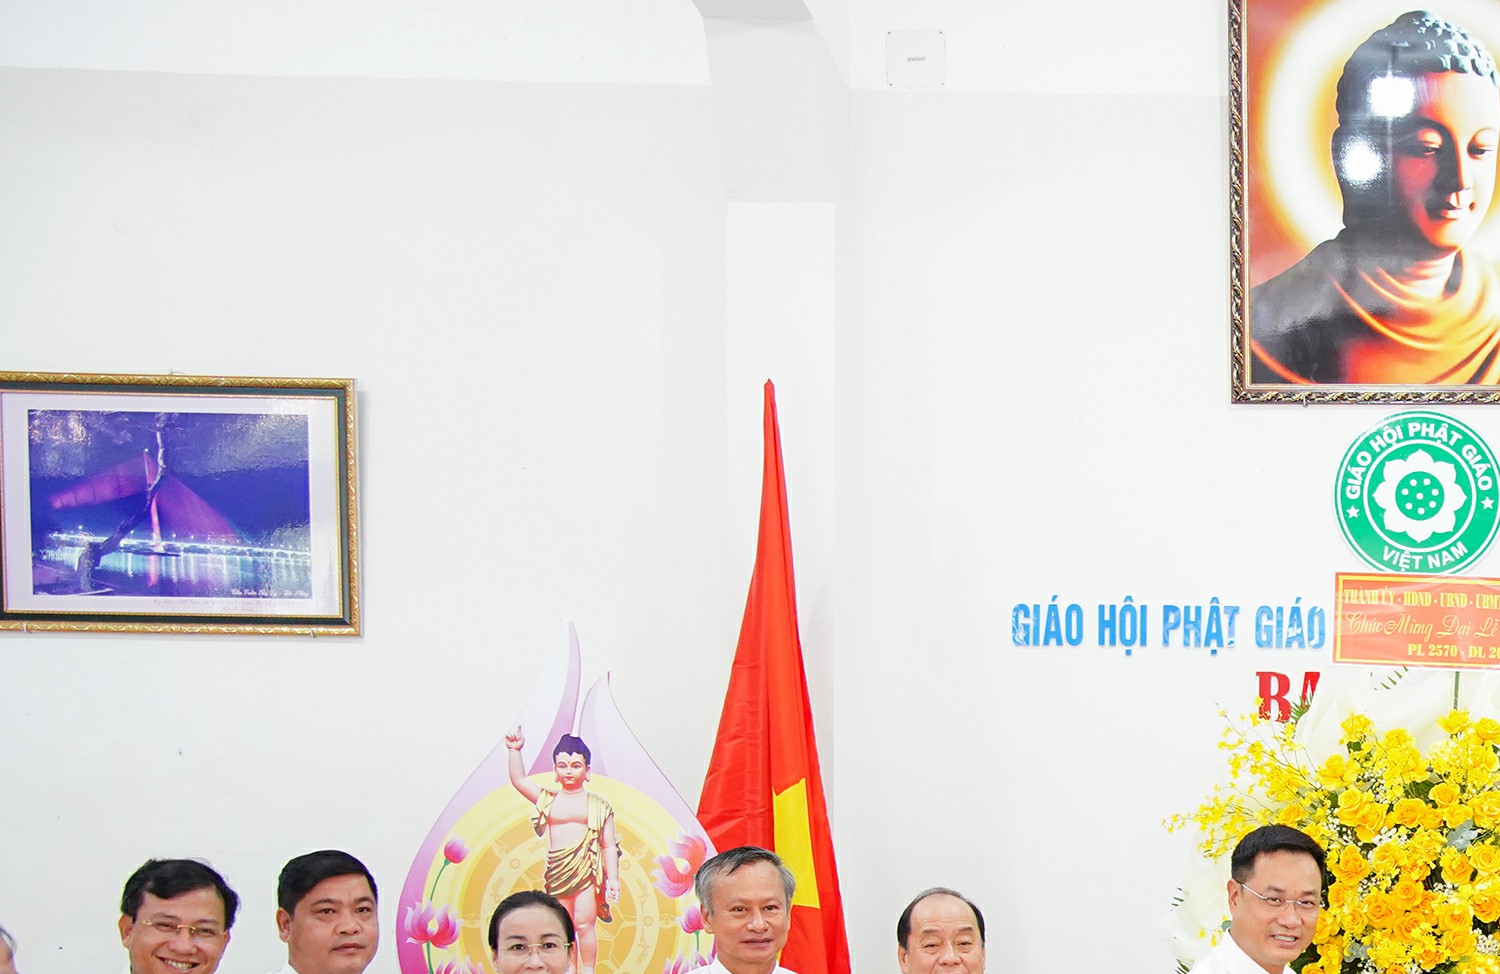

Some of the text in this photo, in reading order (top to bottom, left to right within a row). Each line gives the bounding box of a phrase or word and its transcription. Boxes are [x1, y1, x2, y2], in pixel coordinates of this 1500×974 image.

[1345, 422, 1493, 500] GIÁO HỘI PHẬT GIÁO
[1383, 541, 1469, 572] VIỆT NAM
[1344, 586, 1379, 605] THÀNH
[1440, 592, 1468, 609] UBND
[1011, 594, 1084, 647] GIÁO
[1098, 595, 1148, 656] HỘI
[1162, 596, 1240, 657] PHẬT
[1255, 597, 1326, 649] GIÁO
[1346, 611, 1383, 634] Chúc
[1384, 613, 1434, 643] Mừng
[1473, 616, 1500, 638] Lễ
[1407, 643, 1425, 657] PL
[1428, 644, 1458, 658] 2570
